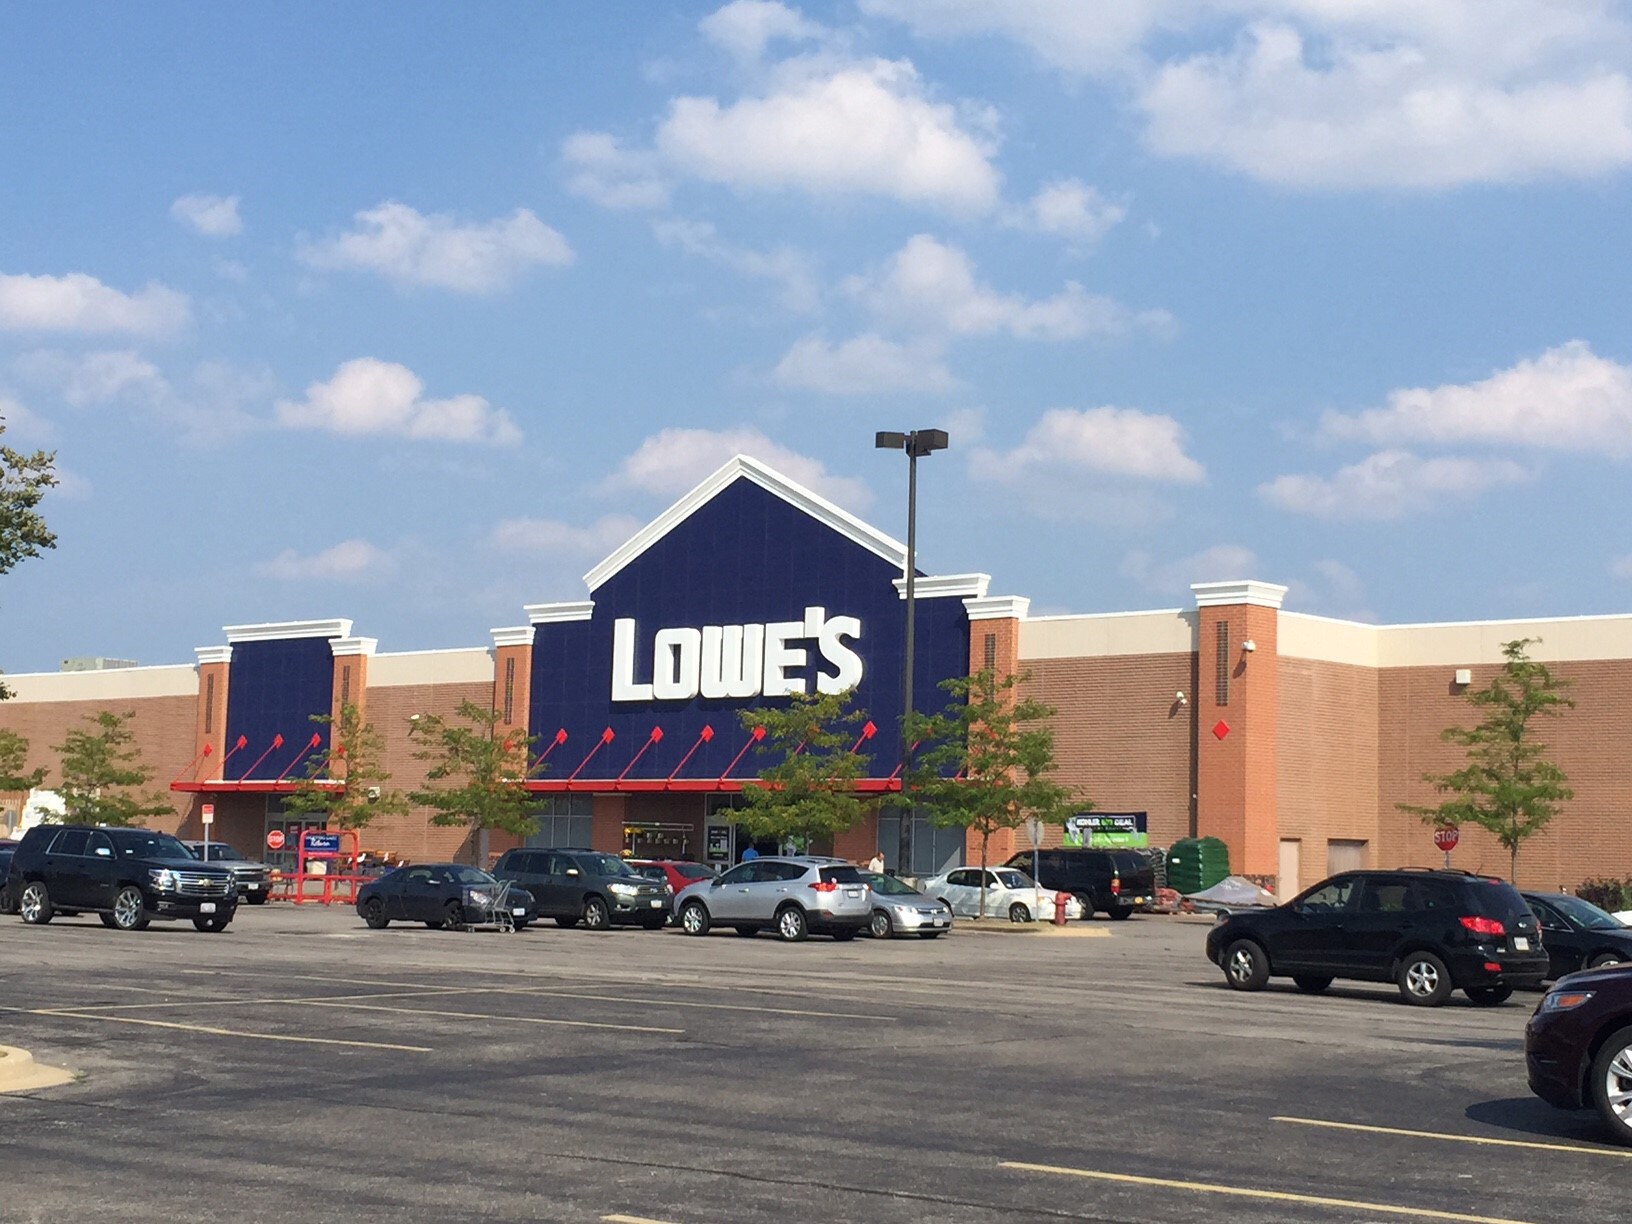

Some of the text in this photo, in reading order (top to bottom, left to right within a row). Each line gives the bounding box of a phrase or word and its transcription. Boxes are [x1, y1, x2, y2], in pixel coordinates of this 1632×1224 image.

[611, 606, 863, 702] LOWE'S
[269, 835, 284, 844] STOP
[1434, 830, 1458, 843] STOP
